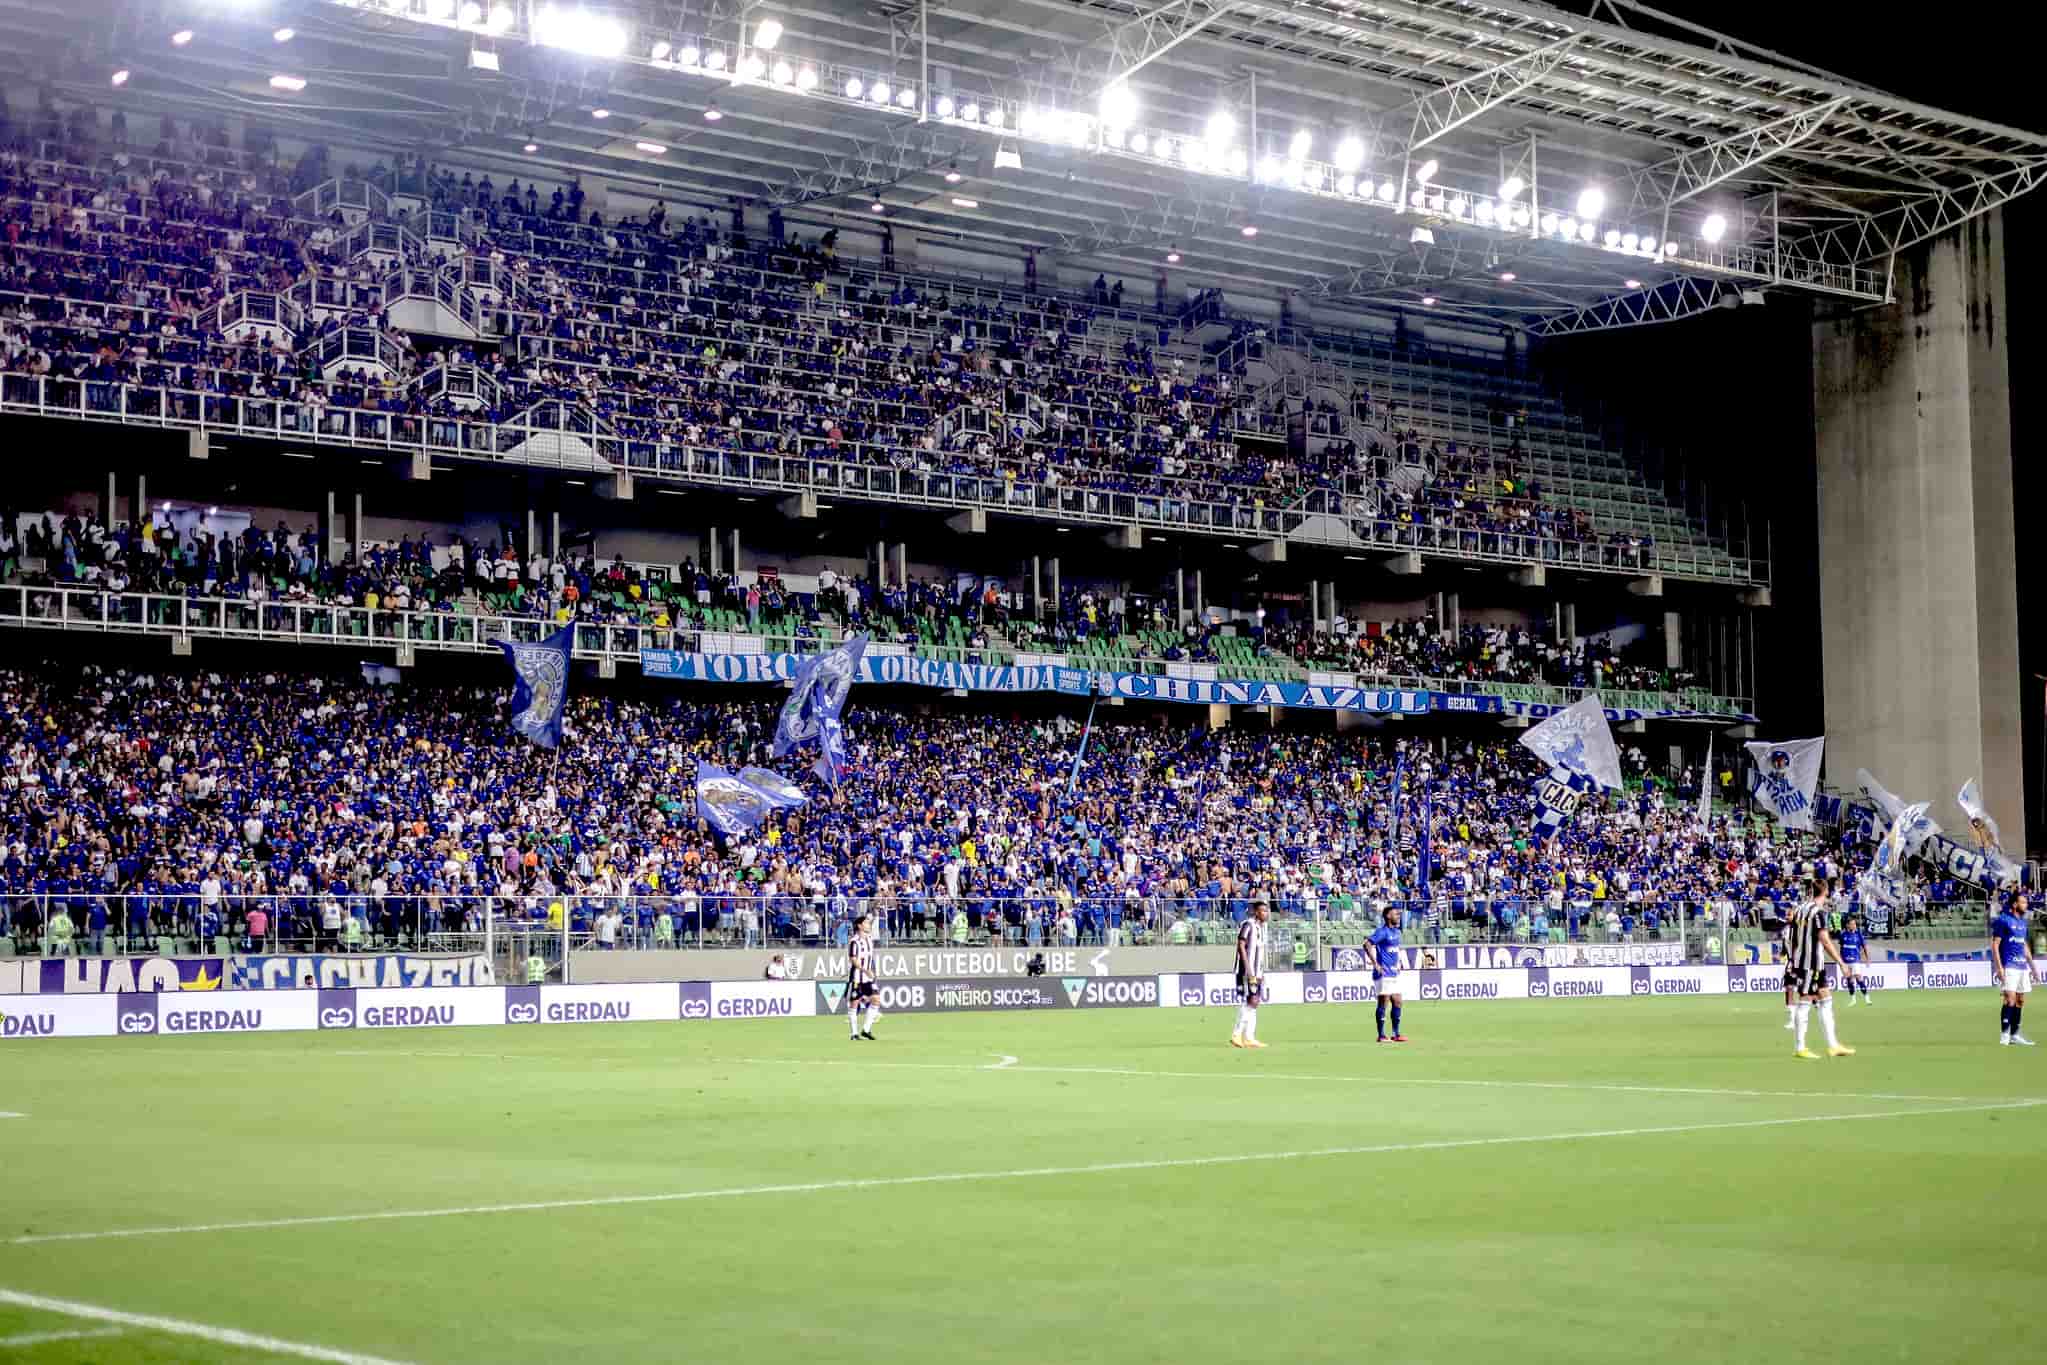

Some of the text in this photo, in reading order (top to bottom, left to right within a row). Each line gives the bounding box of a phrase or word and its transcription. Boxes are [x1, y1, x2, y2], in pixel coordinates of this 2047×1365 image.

[689, 653, 1057, 692] TORCA ORGANIZADA
[1117, 672, 1427, 713] CHINA AZUL
[813, 953, 911, 977] AMICA
[914, 952, 1008, 976] FUTEBOL
[1013, 951, 1077, 974] CBE
[1553, 981, 1603, 996] GERDAU
[1654, 979, 1701, 993] GERDAU
[1750, 977, 1784, 991] GERDA
[1841, 975, 1884, 989] GDAU
[1928, 973, 1968, 987] GERDAU
[935, 989, 991, 1007] MINEIRO
[1086, 981, 1157, 1003] SICOOB
[1210, 987, 1270, 1004] GERU
[1331, 985, 1376, 1001] GERDA
[1446, 983, 1498, 998] GERDAU
[364, 1005, 454, 1027] GERDAU
[547, 1001, 630, 1021] GERDAU
[717, 997, 792, 1017] GERDAU
[0, 1013, 55, 1036] DAU
[166, 1009, 262, 1032] GERDAU
